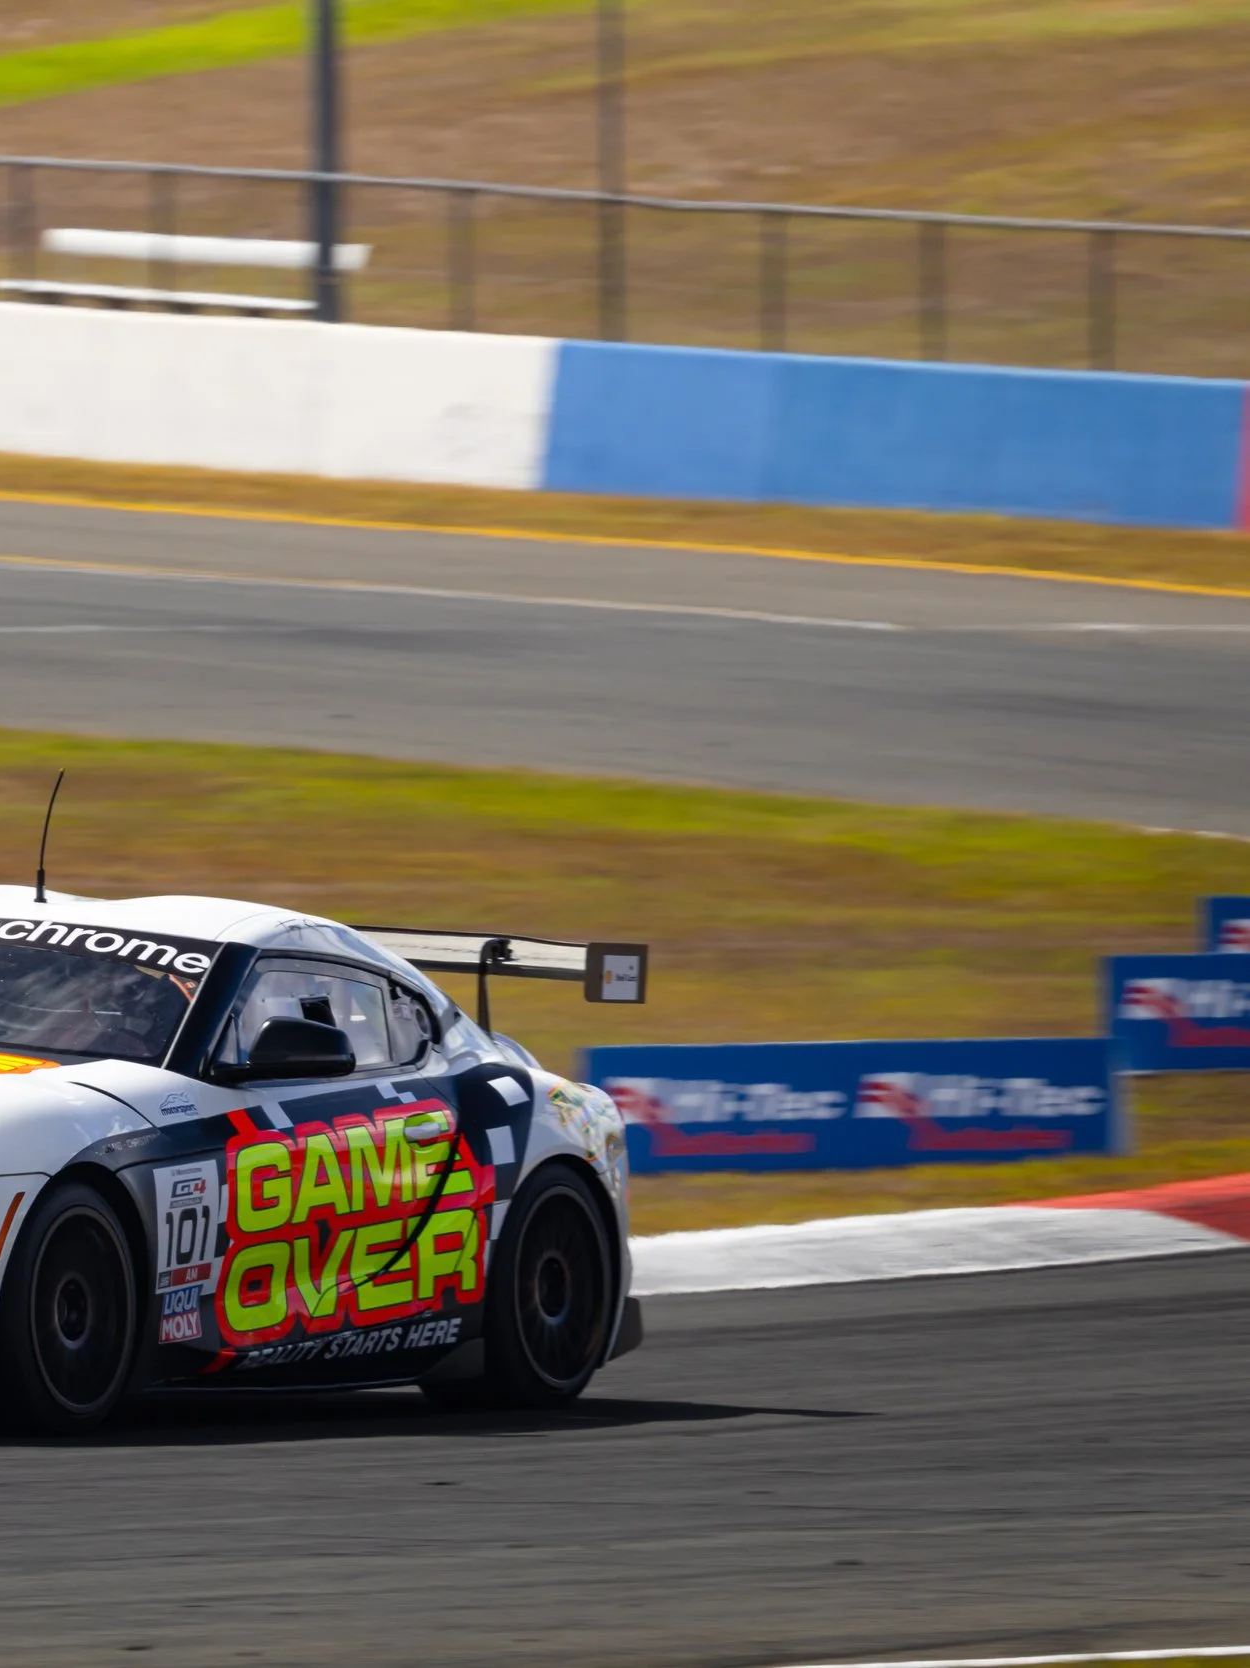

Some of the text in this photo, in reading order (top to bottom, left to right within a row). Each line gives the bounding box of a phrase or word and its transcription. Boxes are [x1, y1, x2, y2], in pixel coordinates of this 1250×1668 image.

[235, 1110, 475, 1233] GAME
[165, 1205, 210, 1267] 101
[223, 1208, 480, 1333] OVER
[161, 1311, 199, 1341] MOLY
[164, 1289, 200, 1315] LIQUI
[323, 1327, 403, 1360] STARTS
[403, 1317, 463, 1349] HERE
